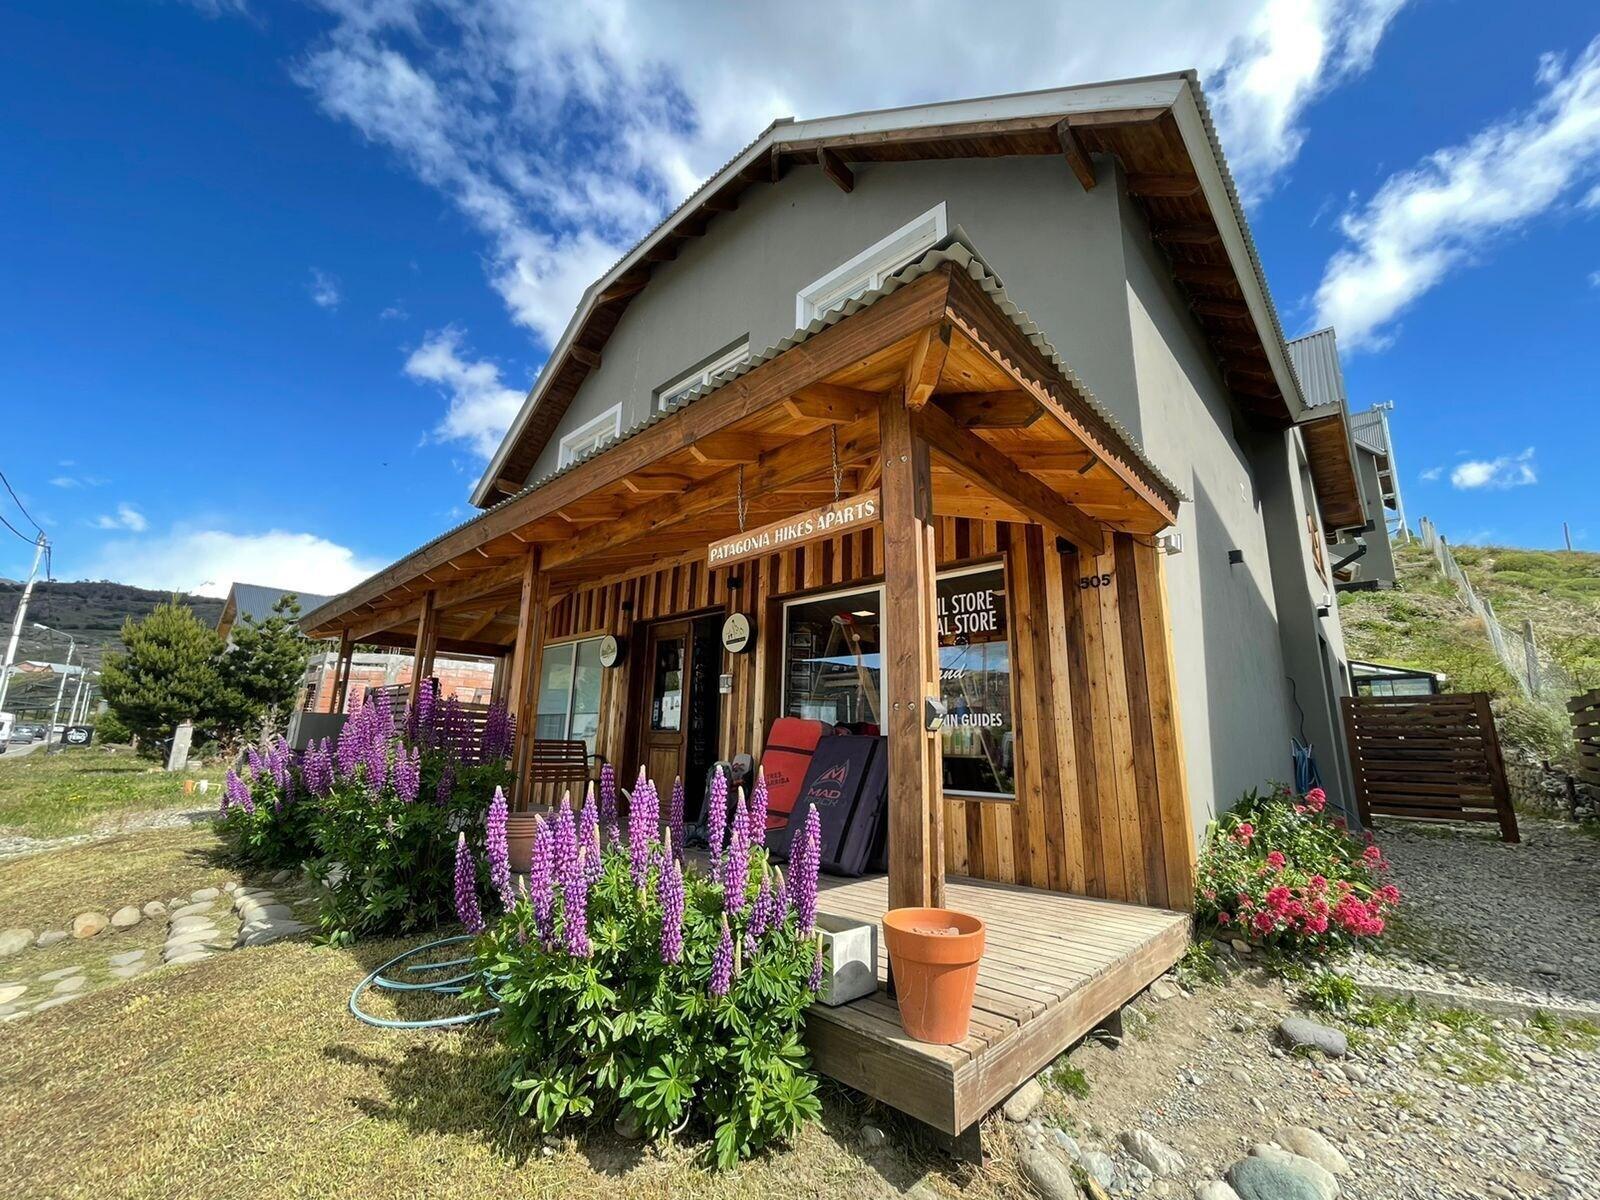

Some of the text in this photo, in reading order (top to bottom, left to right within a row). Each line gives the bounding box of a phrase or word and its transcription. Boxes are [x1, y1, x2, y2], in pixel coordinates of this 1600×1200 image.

[710, 499, 875, 562] PATAGONIA HIKES APARTS
[1079, 574, 1112, 590] 505
[951, 589, 994, 614] STORE
[954, 610, 997, 634] STORE
[961, 713, 1003, 727] GUIDES
[807, 787, 841, 799] MAD
